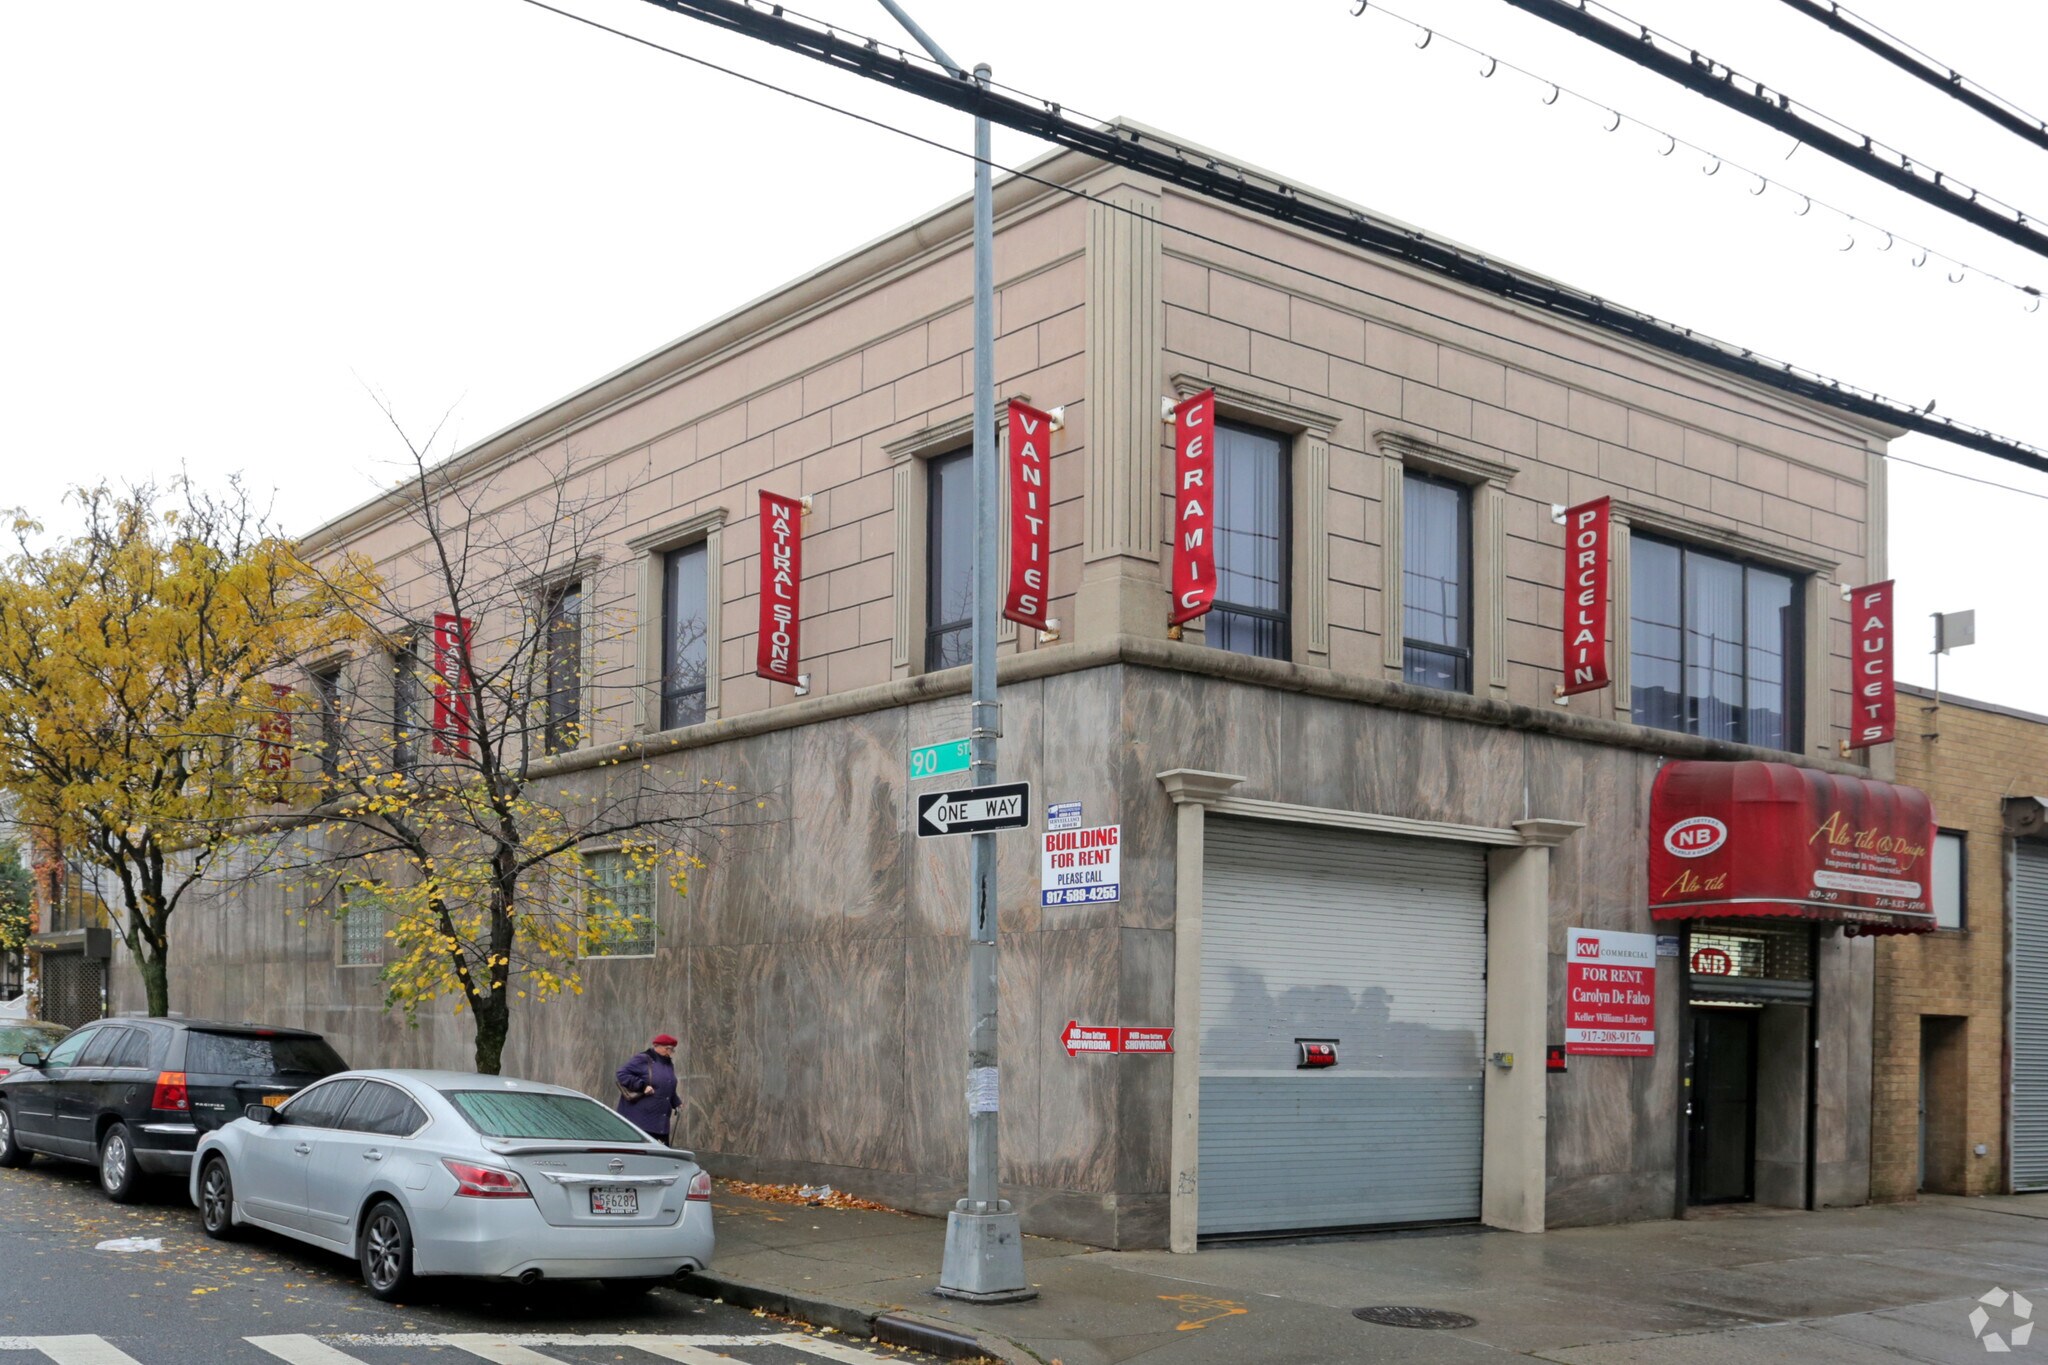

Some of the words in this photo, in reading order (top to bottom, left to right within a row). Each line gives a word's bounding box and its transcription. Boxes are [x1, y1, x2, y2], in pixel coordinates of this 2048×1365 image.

[1017, 412, 1044, 616] VANITIES
[1180, 403, 1205, 609] CERAMIC
[771, 502, 793, 600] NATURAL
[1572, 509, 1598, 685] PORCELAIN
[769, 603, 792, 675] STONE
[1862, 591, 1885, 742] FAUCETS
[912, 748, 938, 776] 90
[957, 742, 970, 756] ST
[937, 803, 969, 823] ONE
[985, 797, 1019, 817] WAY
[1045, 827, 1118, 852] BUILDING
[1679, 828, 1711, 846] NB
[1808, 811, 1852, 846] Alto
[1854, 827, 1878, 850] Tile
[1892, 837, 1927, 871] Design
[1051, 852, 1074, 869] FOR
[1078, 848, 1112, 866] RENT
[1824, 858, 1860, 869] Imported
[1868, 863, 1903, 875] Domestic
[1830, 848, 1861, 860] Custom
[1861, 852, 1897, 865] Designing
[1057, 872, 1083, 885] PLEASE
[1085, 870, 1102, 882] CALL
[1662, 868, 1700, 898] Alto
[1704, 872, 1728, 891] Tile
[1808, 890, 1838, 900] 89-20
[1577, 943, 1599, 955] KW
[1601, 948, 1648, 959] COMMERCIAL
[1698, 954, 1725, 974] NB
[1582, 967, 1608, 982] FOR
[1610, 970, 1643, 984] RENT
[1572, 986, 1610, 1006] Carolyn
[1612, 988, 1624, 1004] De
[1626, 990, 1651, 1006] Falco
[1574, 1012, 1595, 1022] Keller
[1596, 1012, 1624, 1024] Williams
[1624, 1014, 1648, 1026] Liberty
[1070, 1028, 1081, 1039] NB
[1129, 1031, 1140, 1039] NB
[1581, 1030, 1642, 1043] 917-208-9176
[1067, 1040, 1111, 1050] SHOWROOM
[1125, 1040, 1167, 1050] SHOWROOM
